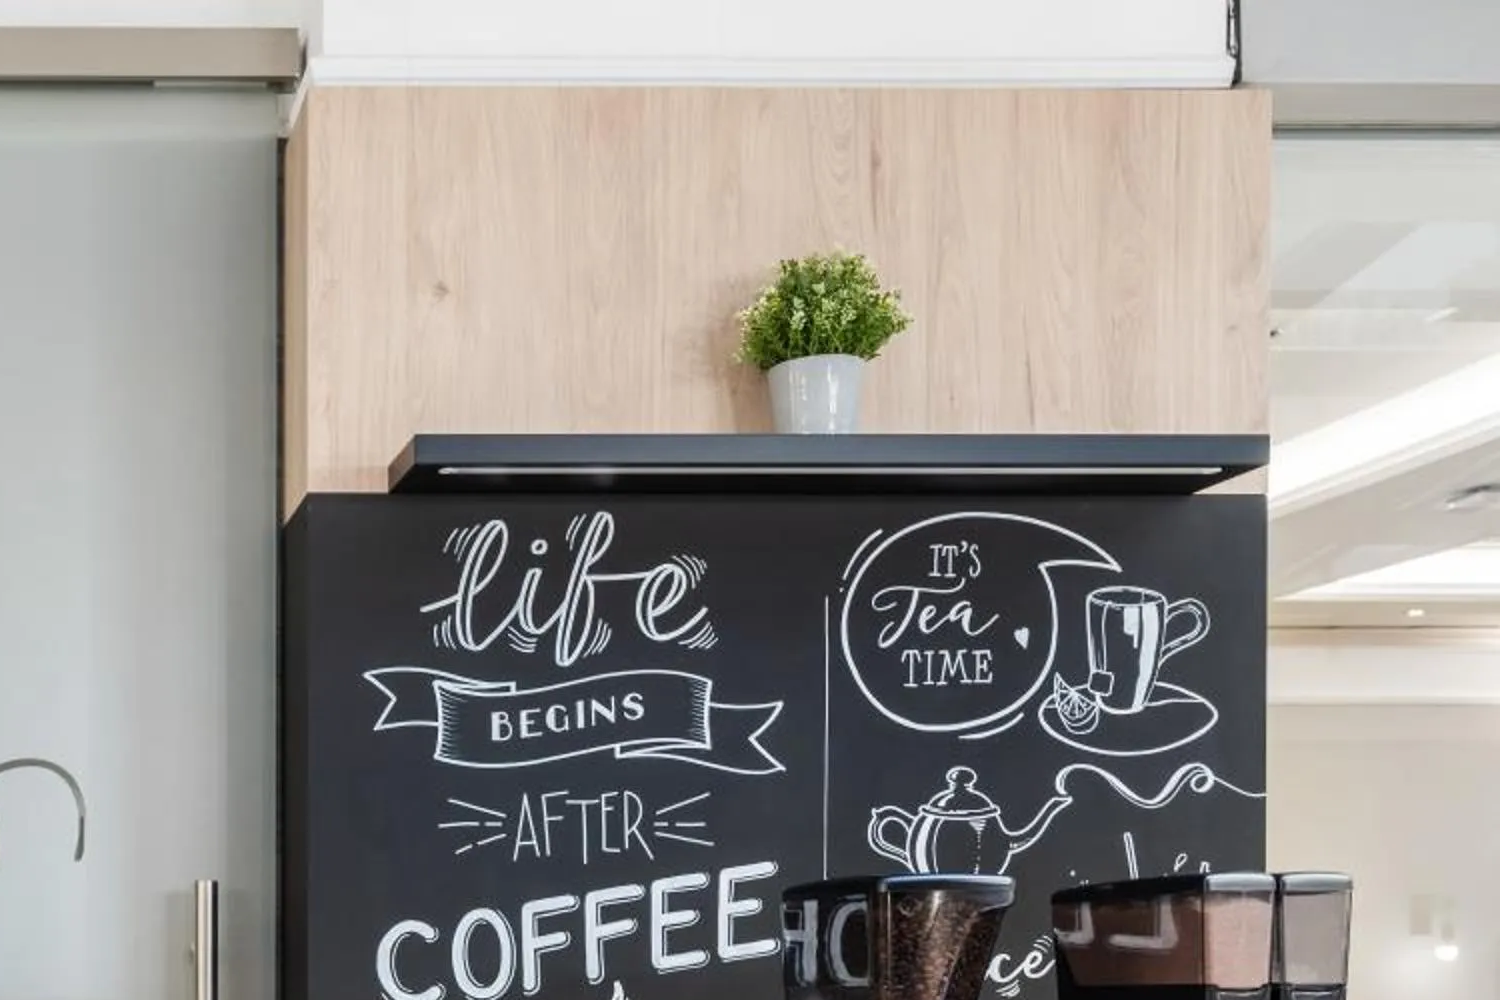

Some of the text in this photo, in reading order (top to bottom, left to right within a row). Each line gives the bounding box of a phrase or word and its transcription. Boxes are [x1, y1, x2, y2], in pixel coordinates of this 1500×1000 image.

[420, 511, 708, 667] life
[928, 541, 982, 577] IT'S
[871, 577, 1000, 649] Tea
[901, 648, 994, 687] TIME
[490, 692, 645, 742] BEGINS
[514, 790, 655, 864] AFTER
